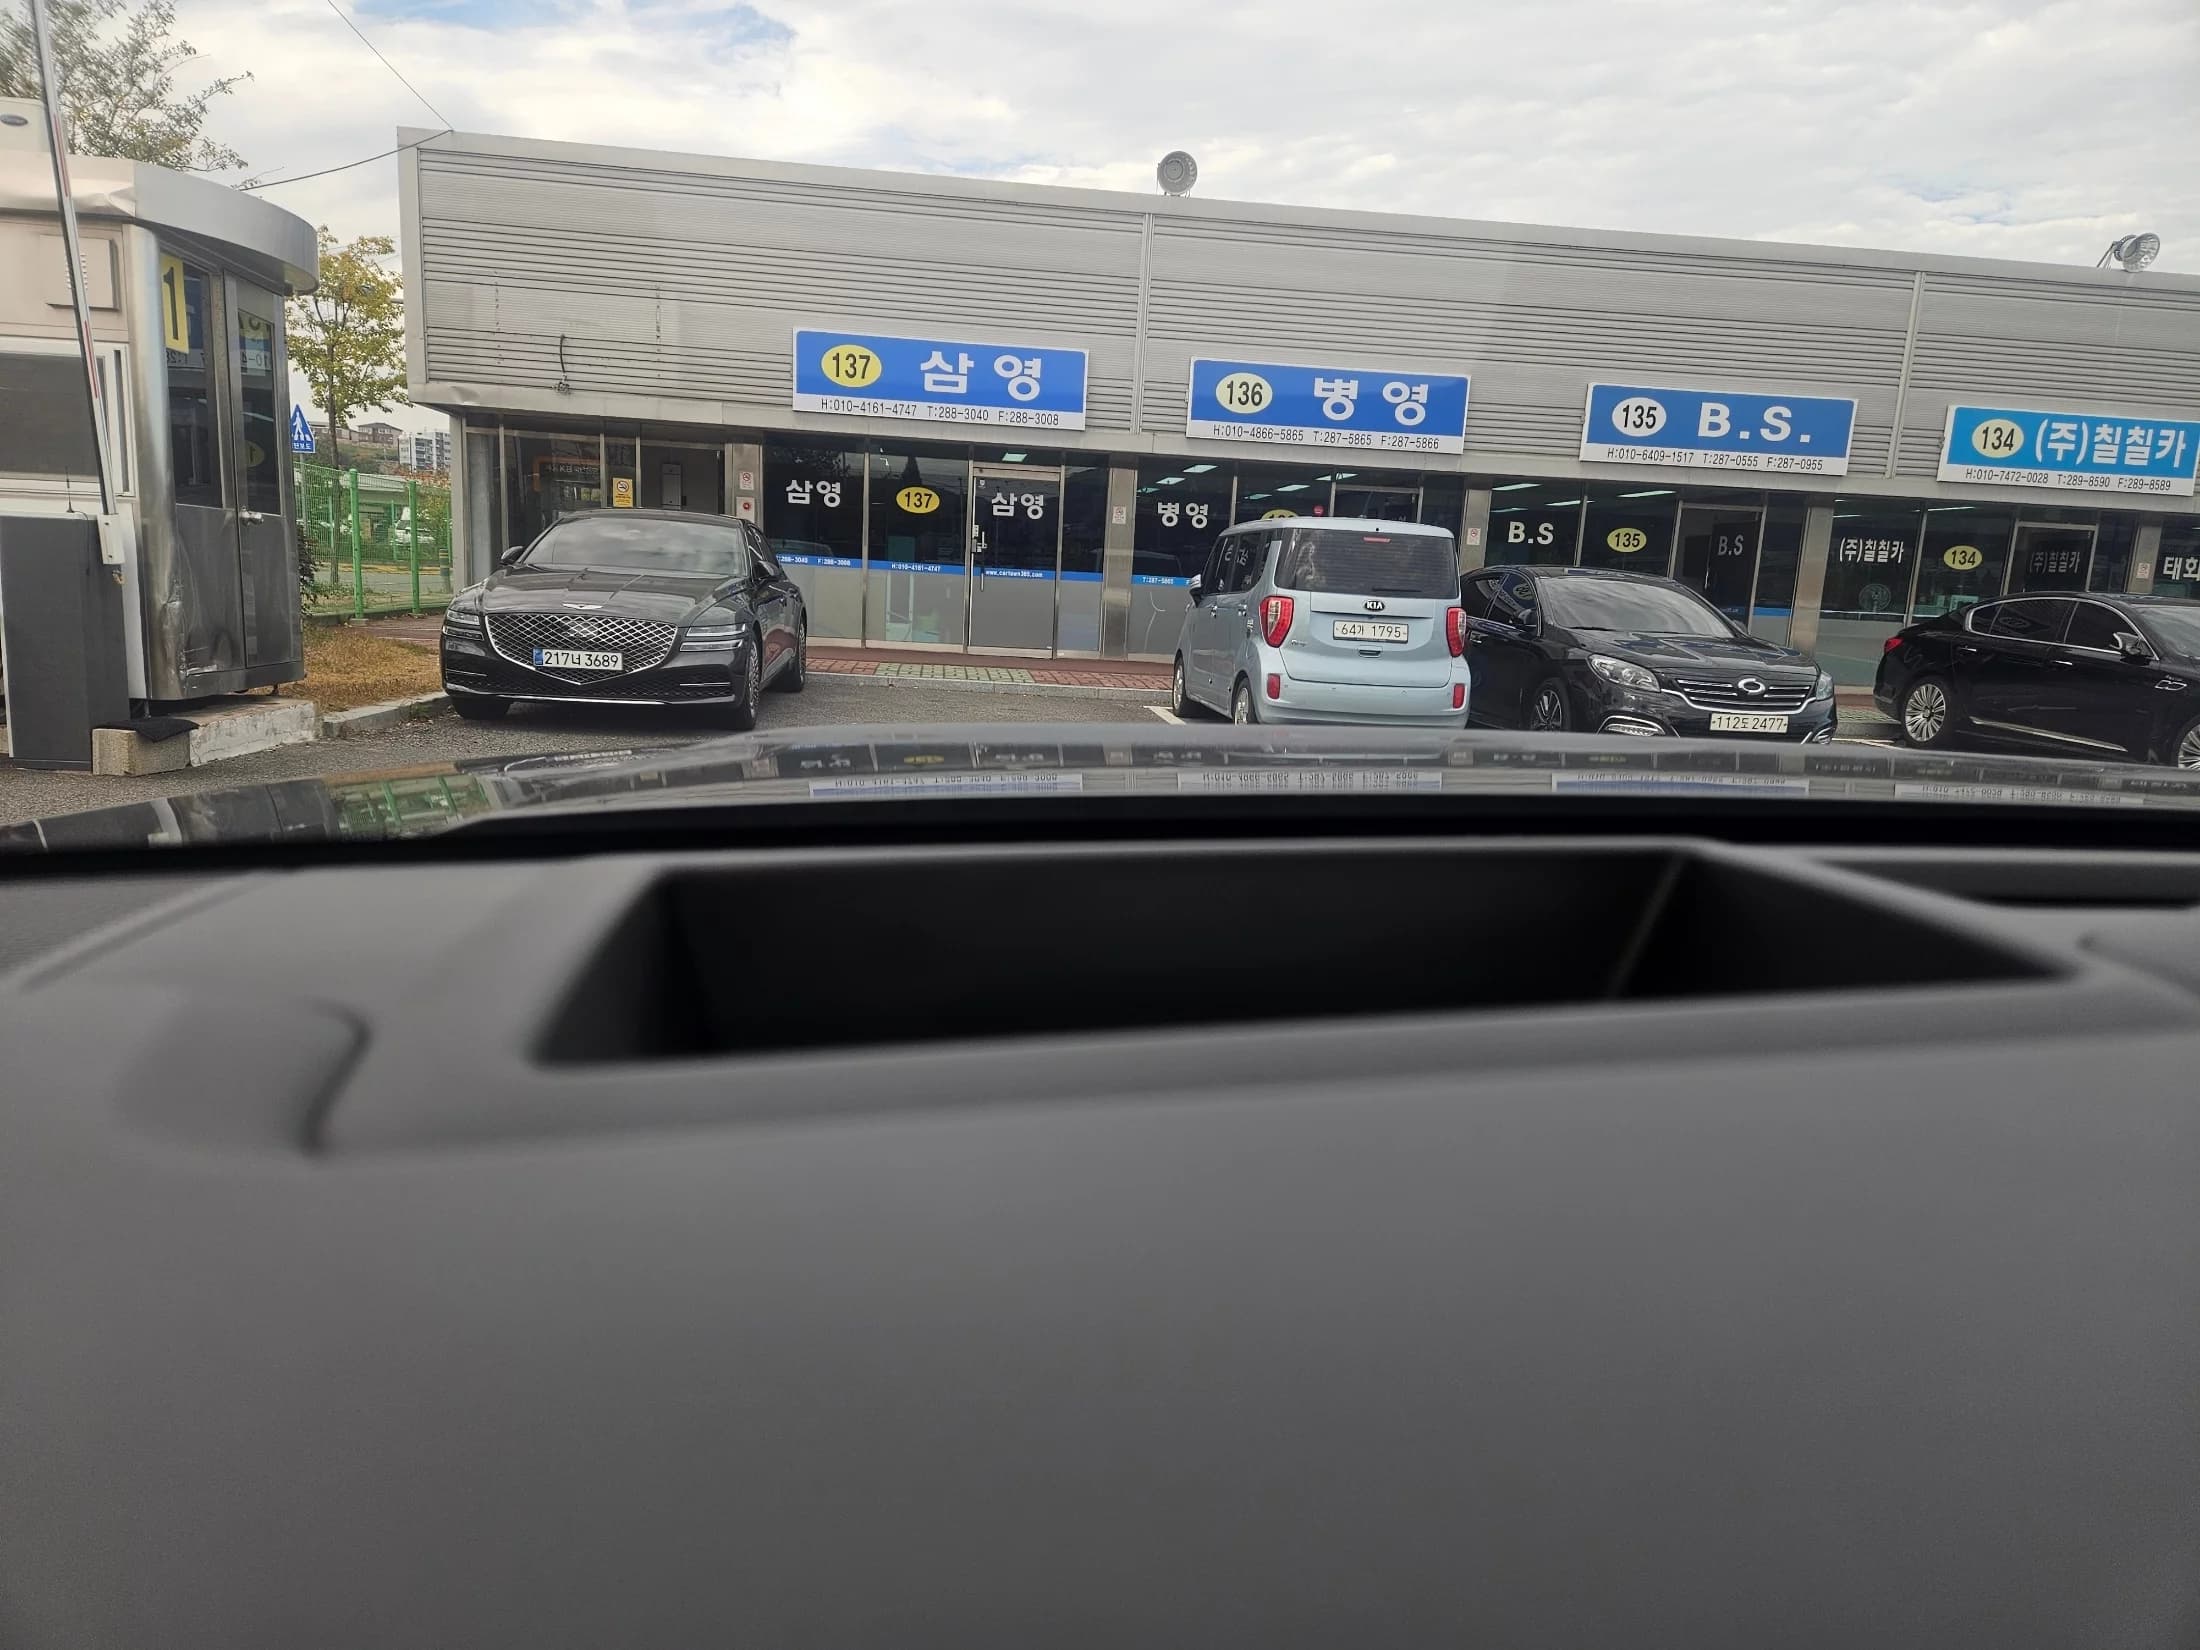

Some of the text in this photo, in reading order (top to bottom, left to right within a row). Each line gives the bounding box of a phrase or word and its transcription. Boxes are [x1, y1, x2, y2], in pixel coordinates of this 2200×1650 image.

[163, 266, 179, 341] 1
[831, 352, 871, 380] 137
[1226, 380, 1263, 407] 136
[820, 398, 1059, 426] H:010-4161-4747 T:288-3040 F:288-3008
[1621, 404, 1657, 429] 135
[1697, 401, 1811, 443] B.S.
[292, 442, 312, 450] 단보도
[1213, 424, 1440, 450] H:010-4866-5865 T:287-5865 F:287-5866
[1981, 426, 2015, 452] 134
[2035, 418, 2187, 468] (주)칠칠카
[1607, 447, 1824, 471] H:010-6409-1517 T:287-0555 F:287-0955
[1965, 468, 2171, 491] H:010-7472-0028 T:289-8590 F:289-8589
[785, 479, 841, 508] 삼영
[904, 491, 932, 509] 137
[991, 492, 1044, 520] 삼영
[1157, 501, 1209, 529] 병영
[1507, 521, 1555, 545] B.S
[1613, 531, 1641, 548] 135
[1717, 534, 1745, 556] B.S
[1839, 537, 1905, 564] (주)칠칠카
[1950, 550, 1977, 566] 134
[1366, 601, 1383, 610] KIA
[1371, 625, 1401, 638] 1795
[544, 651, 619, 668] 217너 3689
[1752, 717, 1784, 731] 2477
